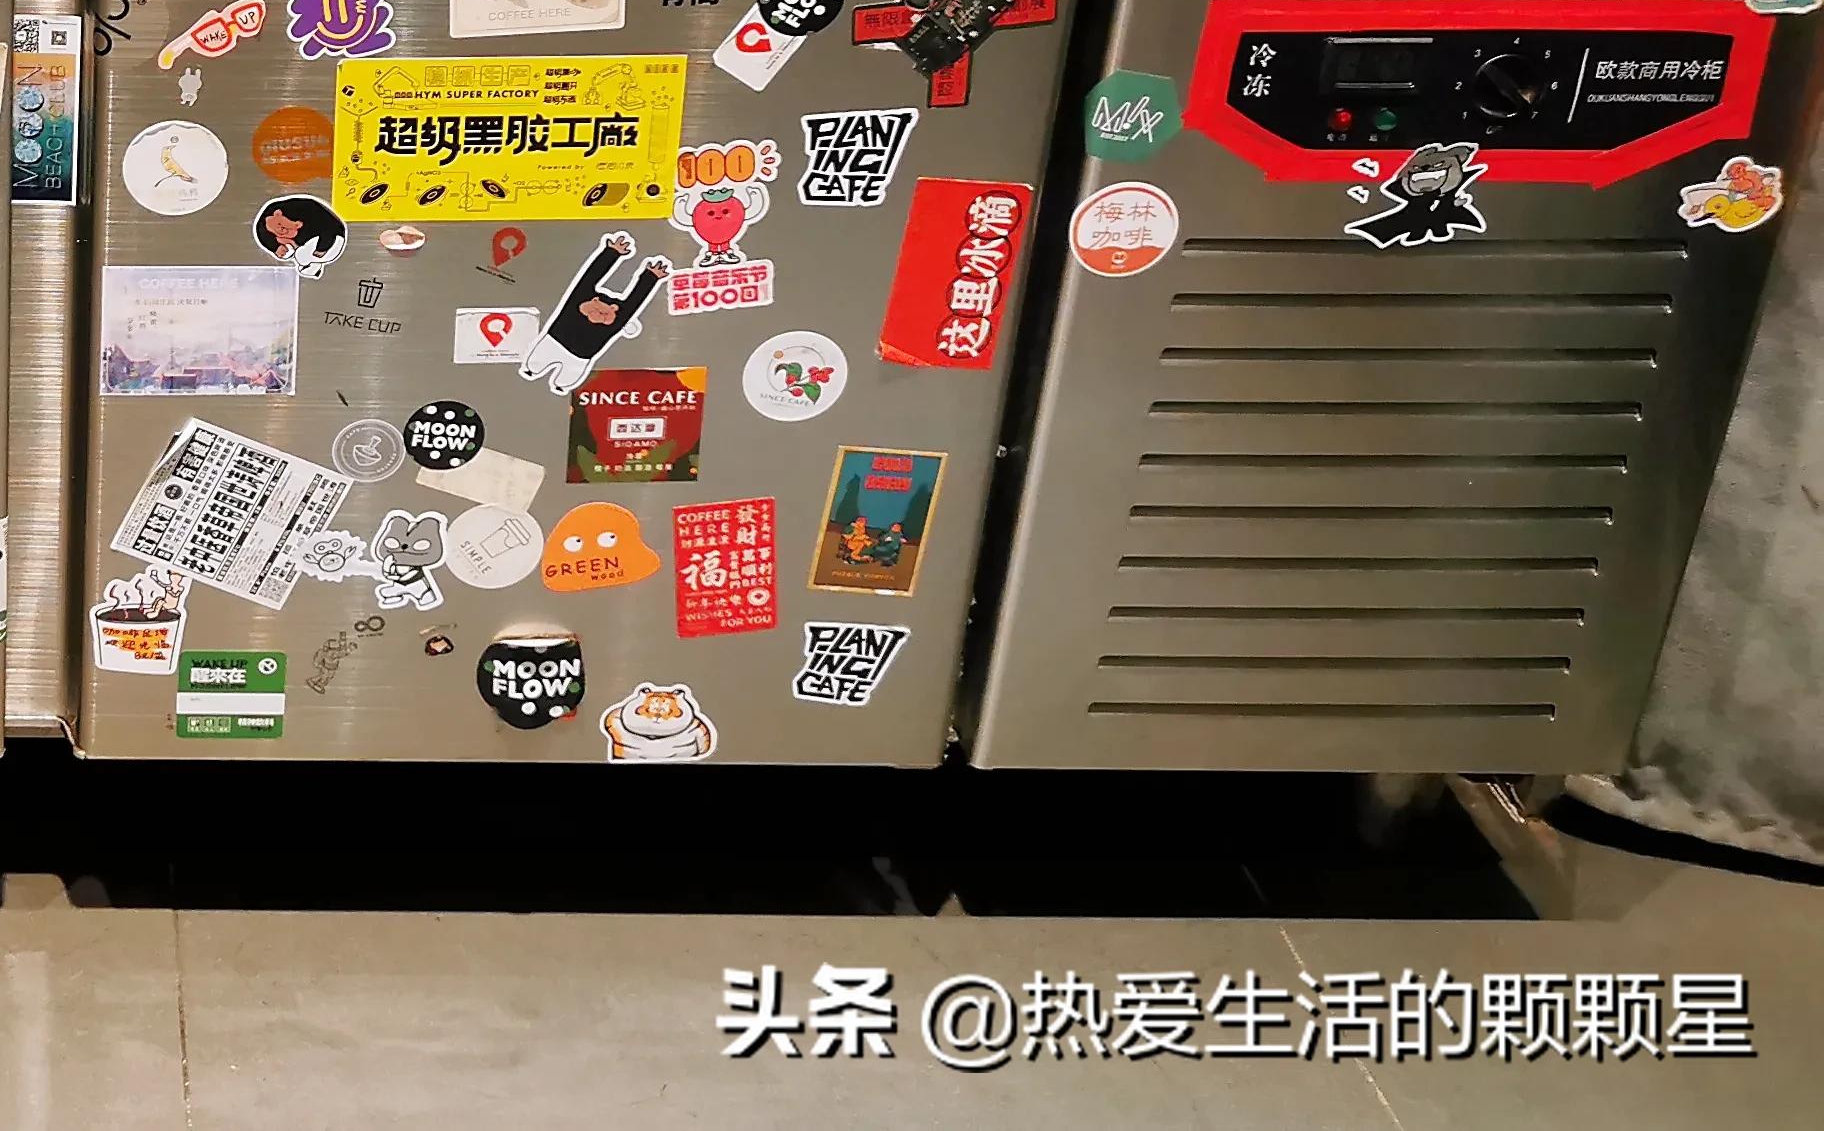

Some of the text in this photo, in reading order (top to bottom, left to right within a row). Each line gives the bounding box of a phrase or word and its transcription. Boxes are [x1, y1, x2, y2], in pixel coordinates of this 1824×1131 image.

[239, 11, 256, 25] UP
[488, 7, 572, 21] COFFEE HERE
[1243, 43, 1277, 97] 冷冻
[1594, 60, 1725, 80] 欧款商用冷柜
[415, 89, 539, 99] HYM SUPER FACTORY
[45, 65, 66, 188] BEACH CLUB
[679, 145, 755, 188] 100
[803, 174, 886, 203] CAFE
[1094, 201, 1157, 223] 梅林
[1090, 226, 1153, 248] 咖啡
[937, 195, 1018, 357] 这里冰滴
[324, 311, 401, 334] TAKE CUP
[579, 390, 696, 405] SINCE CAFE
[413, 421, 476, 439] MOON
[411, 433, 470, 451] FLOW
[678, 509, 730, 524] COFFEE
[679, 522, 729, 537] HERE
[460, 541, 492, 575] SIMPLE
[545, 557, 619, 578] GREEN
[590, 569, 624, 581] wood
[680, 550, 727, 590] 福
[746, 615, 771, 624] YOU
[492, 658, 581, 679] MOON
[492, 676, 573, 699] FLOW
[797, 675, 874, 703] CAFE
